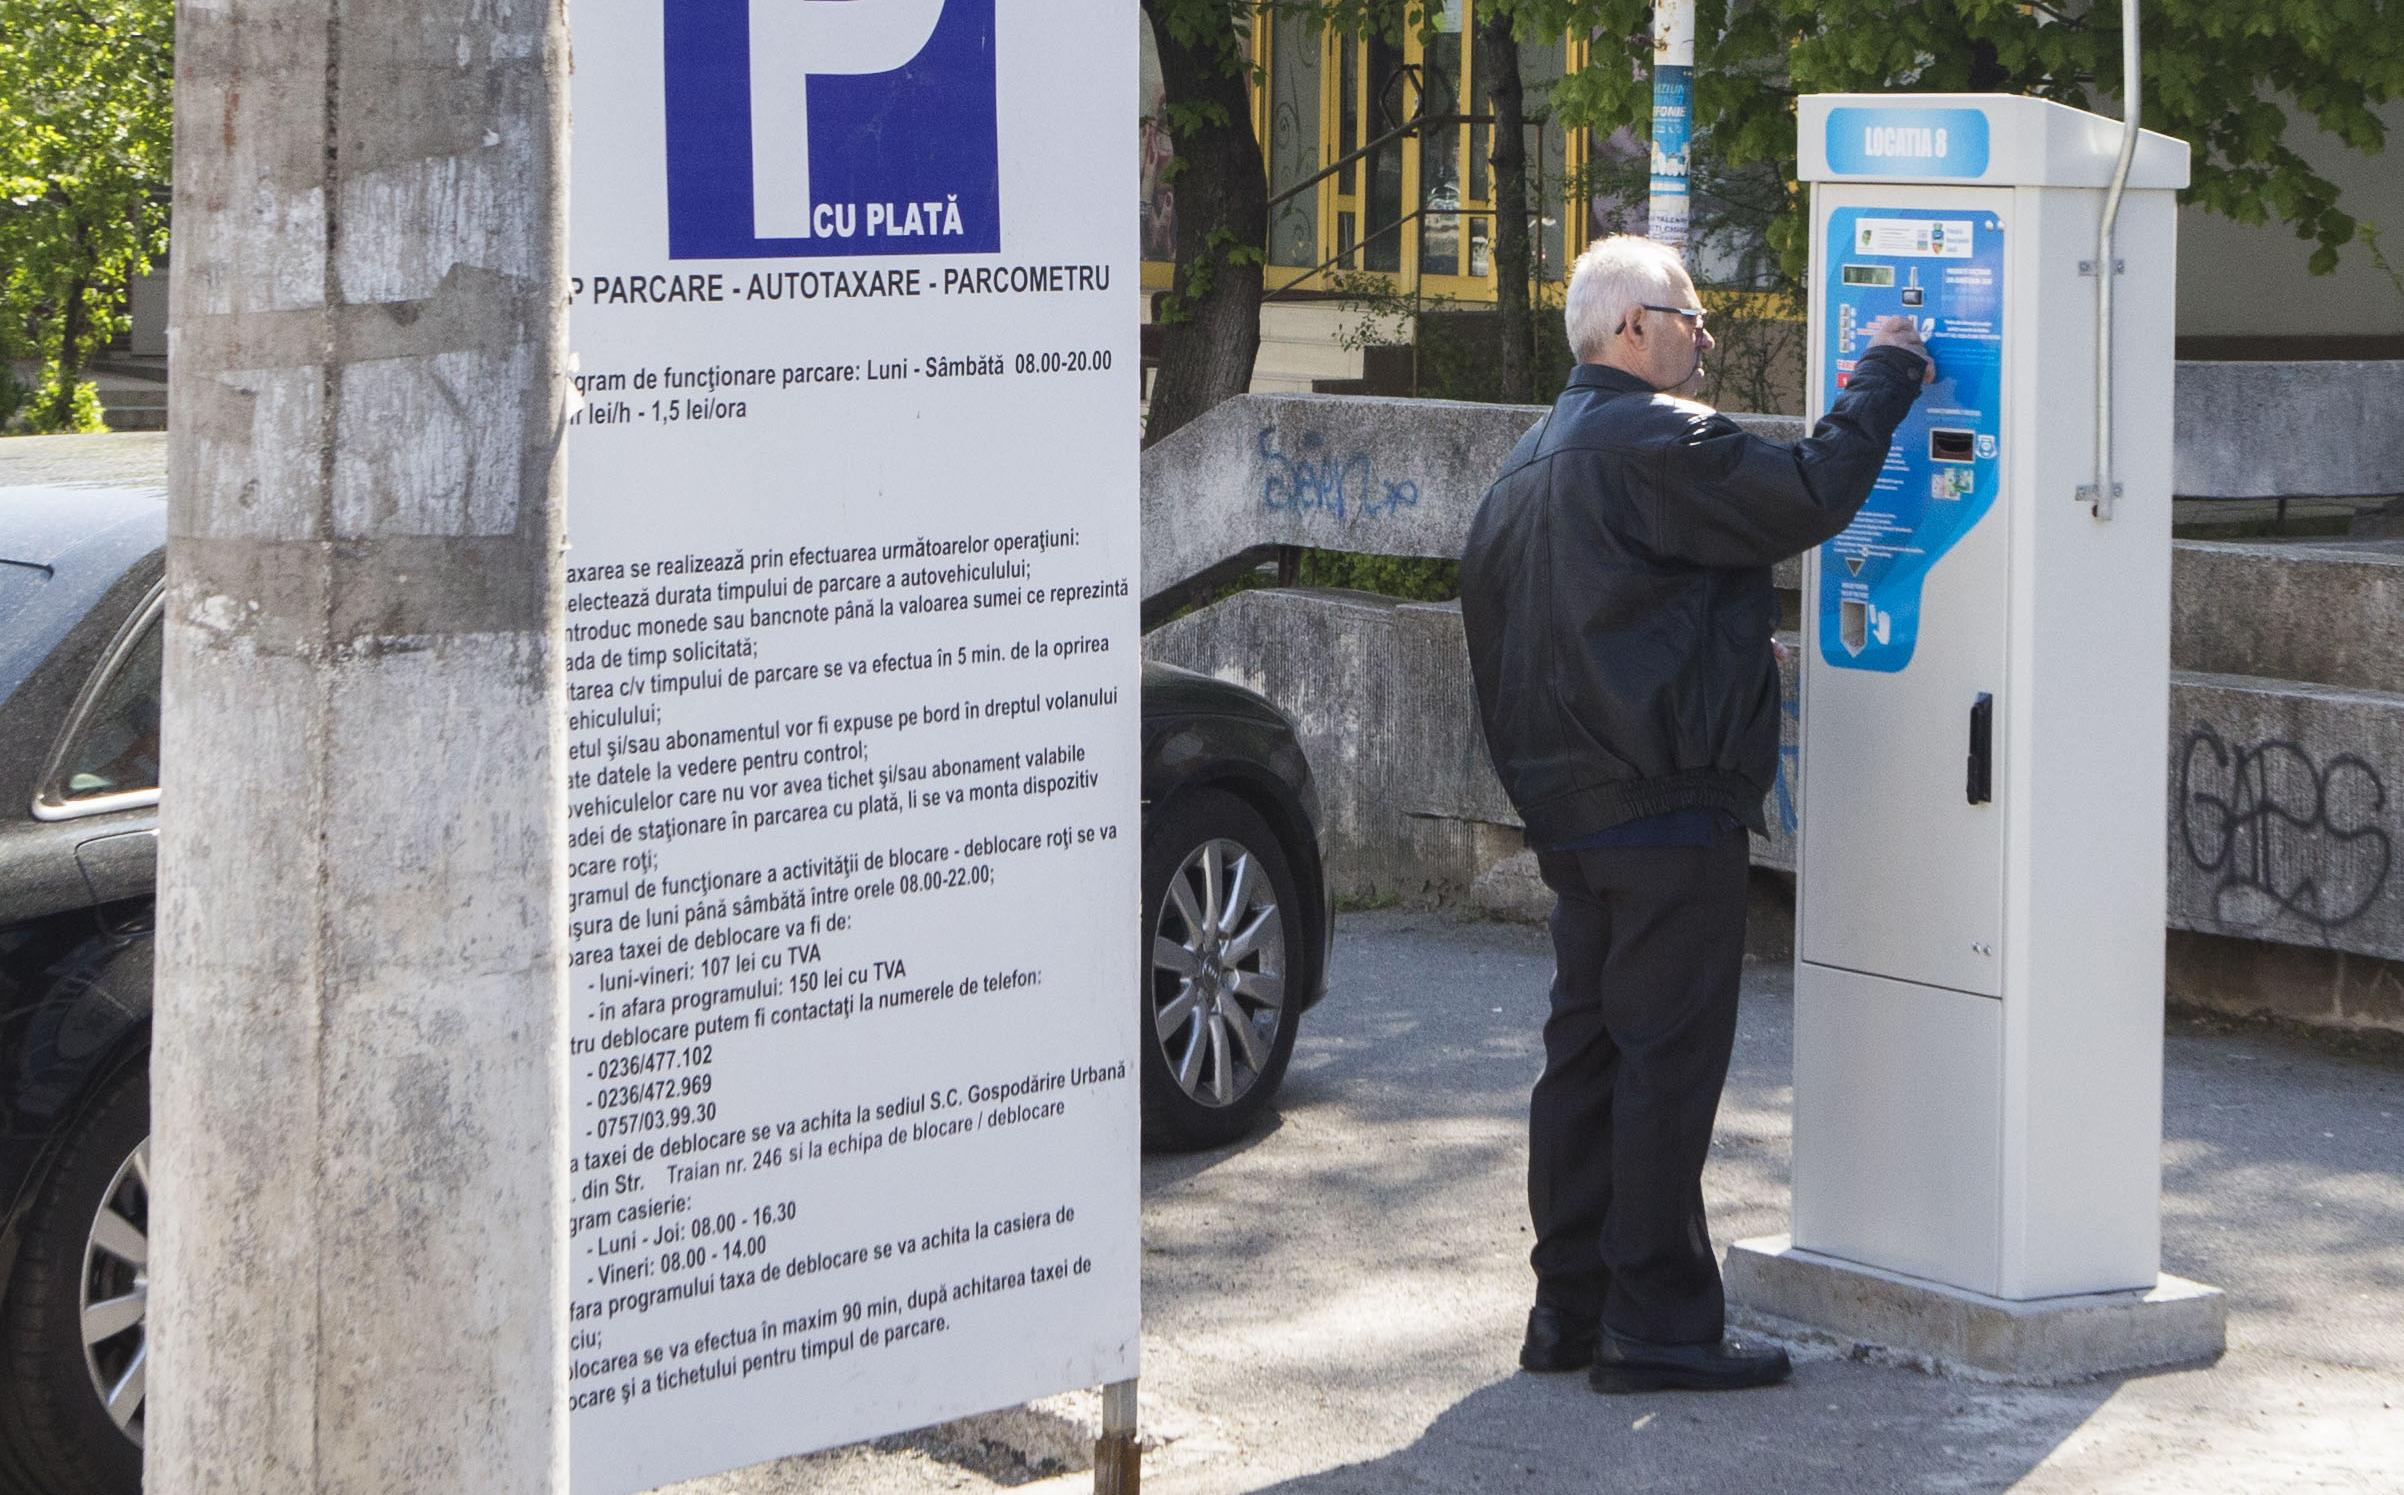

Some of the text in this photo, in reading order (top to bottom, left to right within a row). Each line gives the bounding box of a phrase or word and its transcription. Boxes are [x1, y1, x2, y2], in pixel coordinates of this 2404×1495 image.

[1864, 127, 1932, 157] LOCATIA
[813, 194, 964, 238] CU PLATĂ
[593, 264, 1109, 304] PARCARE AUTOTAXARE PARCOMETRU
[570, 373, 625, 397] gram
[782, 365, 859, 389] parcare:
[867, 358, 907, 380] Luni
[925, 354, 1003, 377] Sâmbătă
[1015, 349, 1111, 374] 08.00-20.00
[589, 397, 746, 425] lei/h 1,5 lei/ora
[657, 548, 744, 576] realizează
[750, 548, 783, 574] prin
[789, 546, 876, 566] efectuarea
[882, 535, 989, 560] următoarelor
[570, 558, 1030, 613] electează durata timpului parcare autovehiculului;
[637, 578, 1128, 636] monede sau bancnote până valoarea sumei ce reprezintă
[619, 635, 1109, 696] c/v timpului parcare efectua în 5 min. oprirea
[627, 637, 757, 669] timp solicitată;
[570, 703, 660, 730] ehiculului;
[666, 720, 779, 750] abonamentul
[785, 721, 813, 737] vor
[833, 713, 892, 736] expuse
[923, 702, 959, 724] bord
[964, 700, 979, 719] în
[984, 693, 1040, 719] dreptul
[1045, 686, 1117, 711] volanului
[570, 790, 673, 818] vehiculelor
[679, 788, 716, 806] care
[722, 786, 744, 802] nu
[749, 782, 778, 798] vor
[783, 777, 822, 795] avea
[827, 768, 874, 790] tichet
[932, 751, 1020, 778] abonament
[1025, 744, 1085, 767] valabile
[597, 740, 867, 786] datele vedere pentru control;
[731, 810, 747, 829] în
[754, 804, 827, 832] parcarea
[858, 791, 902, 819] plată,
[969, 780, 1018, 801] monta
[1023, 769, 1098, 797] dispozitiv
[889, 847, 948, 867] blocare
[964, 834, 1041, 858] deblocare
[646, 864, 994, 927] luni până sâmbătă între orele 08.00-22.00;
[570, 912, 850, 967] area taxei deblocare de:
[600, 943, 821, 992] luni-vineri: 107 lei TVA
[621, 959, 906, 1018] afara programului: 150 lei TVA
[601, 1023, 688, 1050] deblocare
[695, 1014, 748, 1041] putem
[879, 980, 954, 1008] numerele
[983, 969, 1041, 992] telefon:
[598, 1044, 712, 1080] 0236/477.102
[584, 1060, 1125, 1170] taxei deblocare achita sediul S.C. Gospodărire Urbană
[597, 1073, 711, 1109] 0236/472.969
[597, 1101, 716, 1138] 0757/03.99.30
[582, 1101, 1064, 1200] din Str. Traian nr. 246 si echipa blocare deblocare
[598, 1200, 796, 1256] Luni Joi: 08.00 16.30
[617, 1194, 690, 1223] casierie:
[598, 1235, 766, 1285] Vineri: 08.00 14.00
[608, 1212, 1050, 1319] programului taxa deblocare achita casiera
[570, 1258, 1067, 1380] locarea efectua maxim 90 min, după achitarea taxei
[656, 1356, 736, 1391] tichetului
[742, 1348, 795, 1378] pentru
[801, 1330, 853, 1360] timpul
[884, 1317, 949, 1347] parcare.
